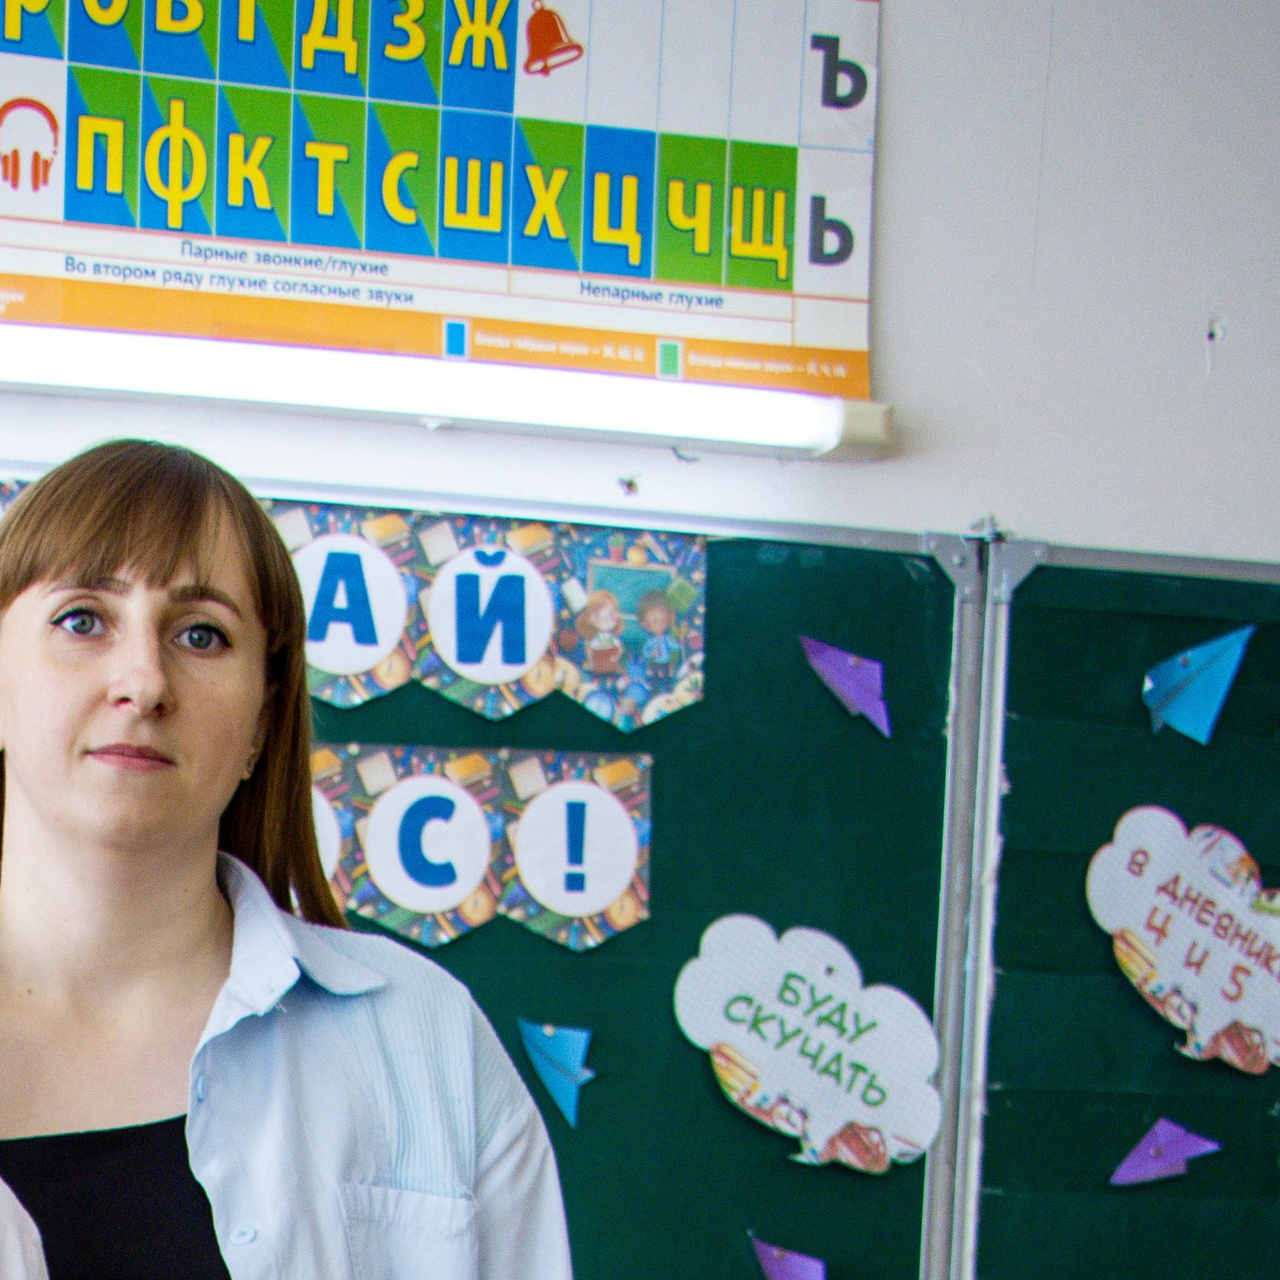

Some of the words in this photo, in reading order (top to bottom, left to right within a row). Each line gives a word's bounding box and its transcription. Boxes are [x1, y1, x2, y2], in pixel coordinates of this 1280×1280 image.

[181, 239, 248, 265] Парные
[255, 250, 389, 277] звонкие/глухие
[65, 256, 86, 274] Во
[93, 264, 156, 283] втором
[162, 270, 203, 288] ряду
[210, 276, 267, 293] глухие
[274, 281, 360, 300] согласные
[368, 289, 414, 306] звуки
[580, 281, 663, 304] Непарные
[668, 292, 724, 310] глухие
[1126, 849, 1149, 877] В
[1156, 874, 1280, 985] ДНЕВНИК
[1221, 964, 1252, 1003] 5
[778, 971, 877, 1043] БУДУ
[724, 994, 887, 1108] СКУЧАТЬ
